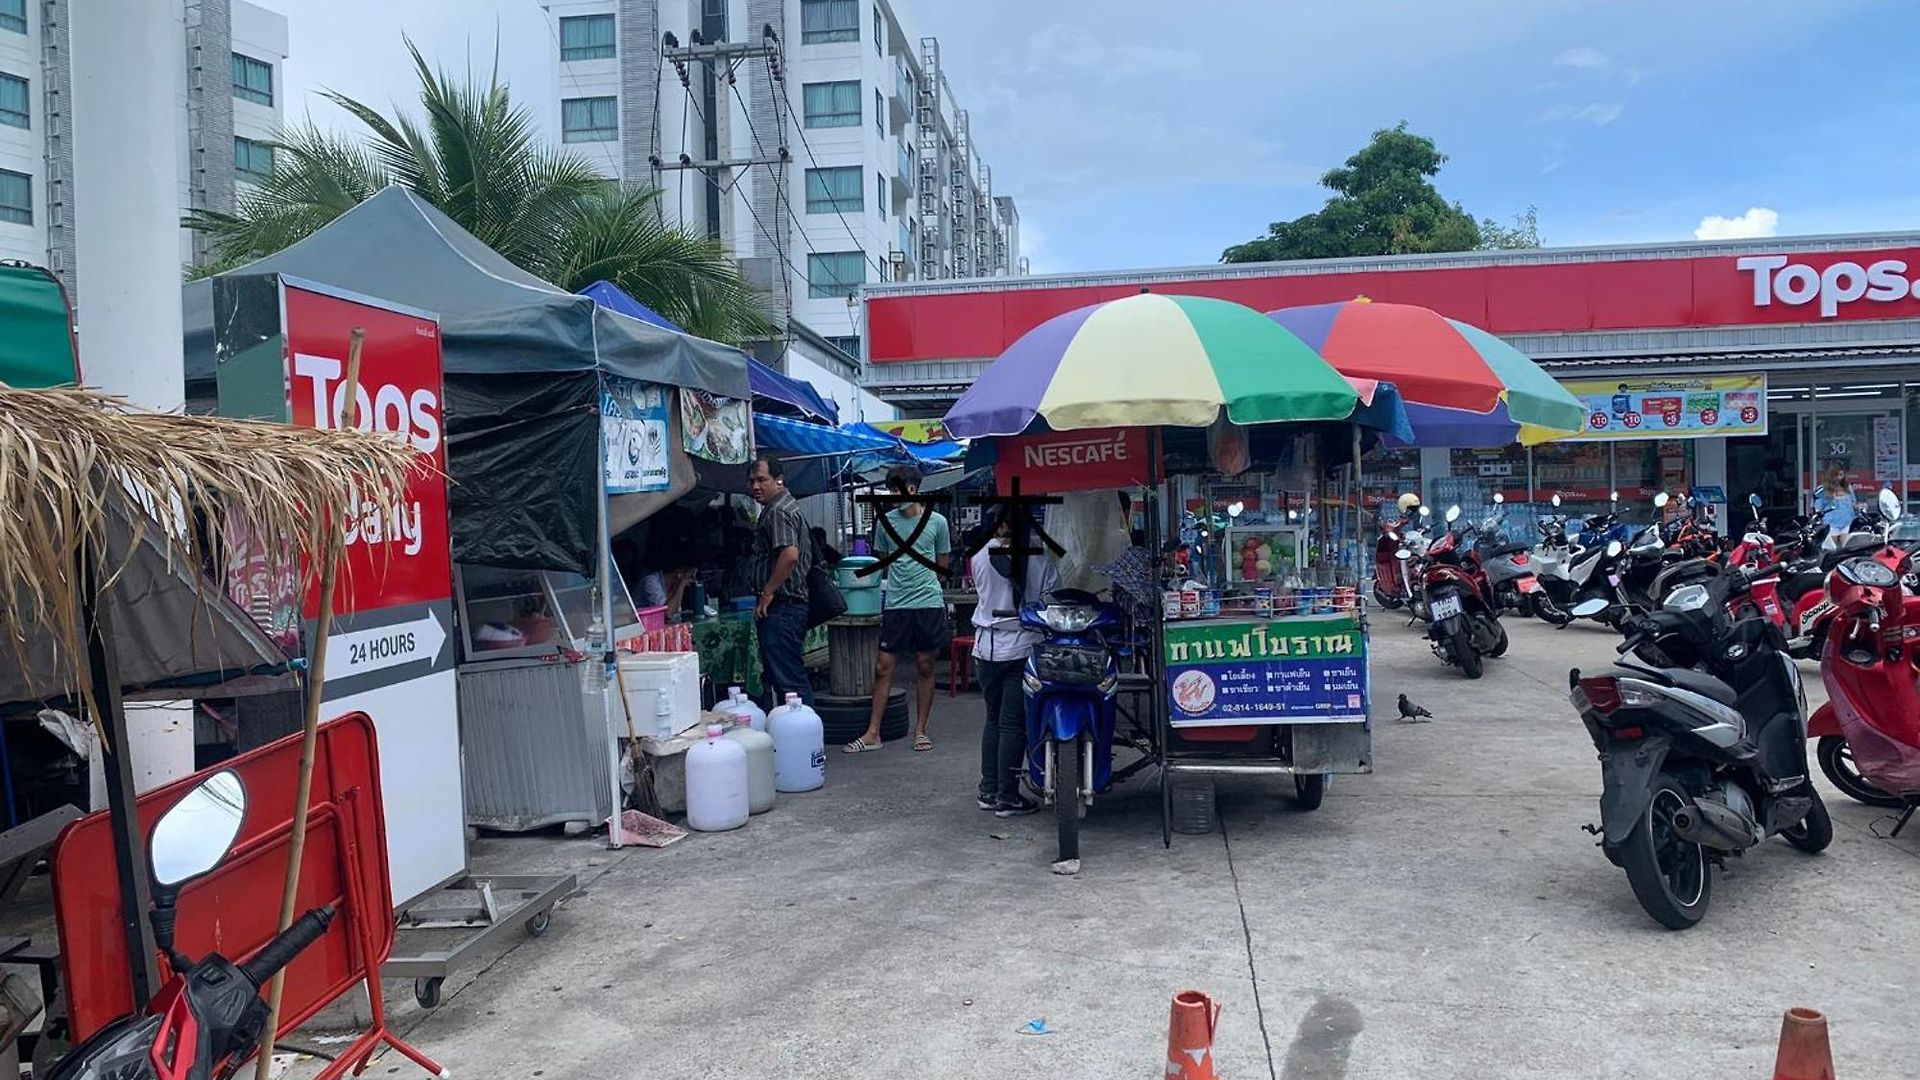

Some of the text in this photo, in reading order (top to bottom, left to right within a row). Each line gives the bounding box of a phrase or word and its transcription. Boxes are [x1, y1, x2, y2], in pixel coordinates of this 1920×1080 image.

[1024, 431, 1127, 468] NESCAFÉ
[350, 631, 416, 665] 24 HOURS
[1170, 627, 1353, 661] กาแฟโบราณ
